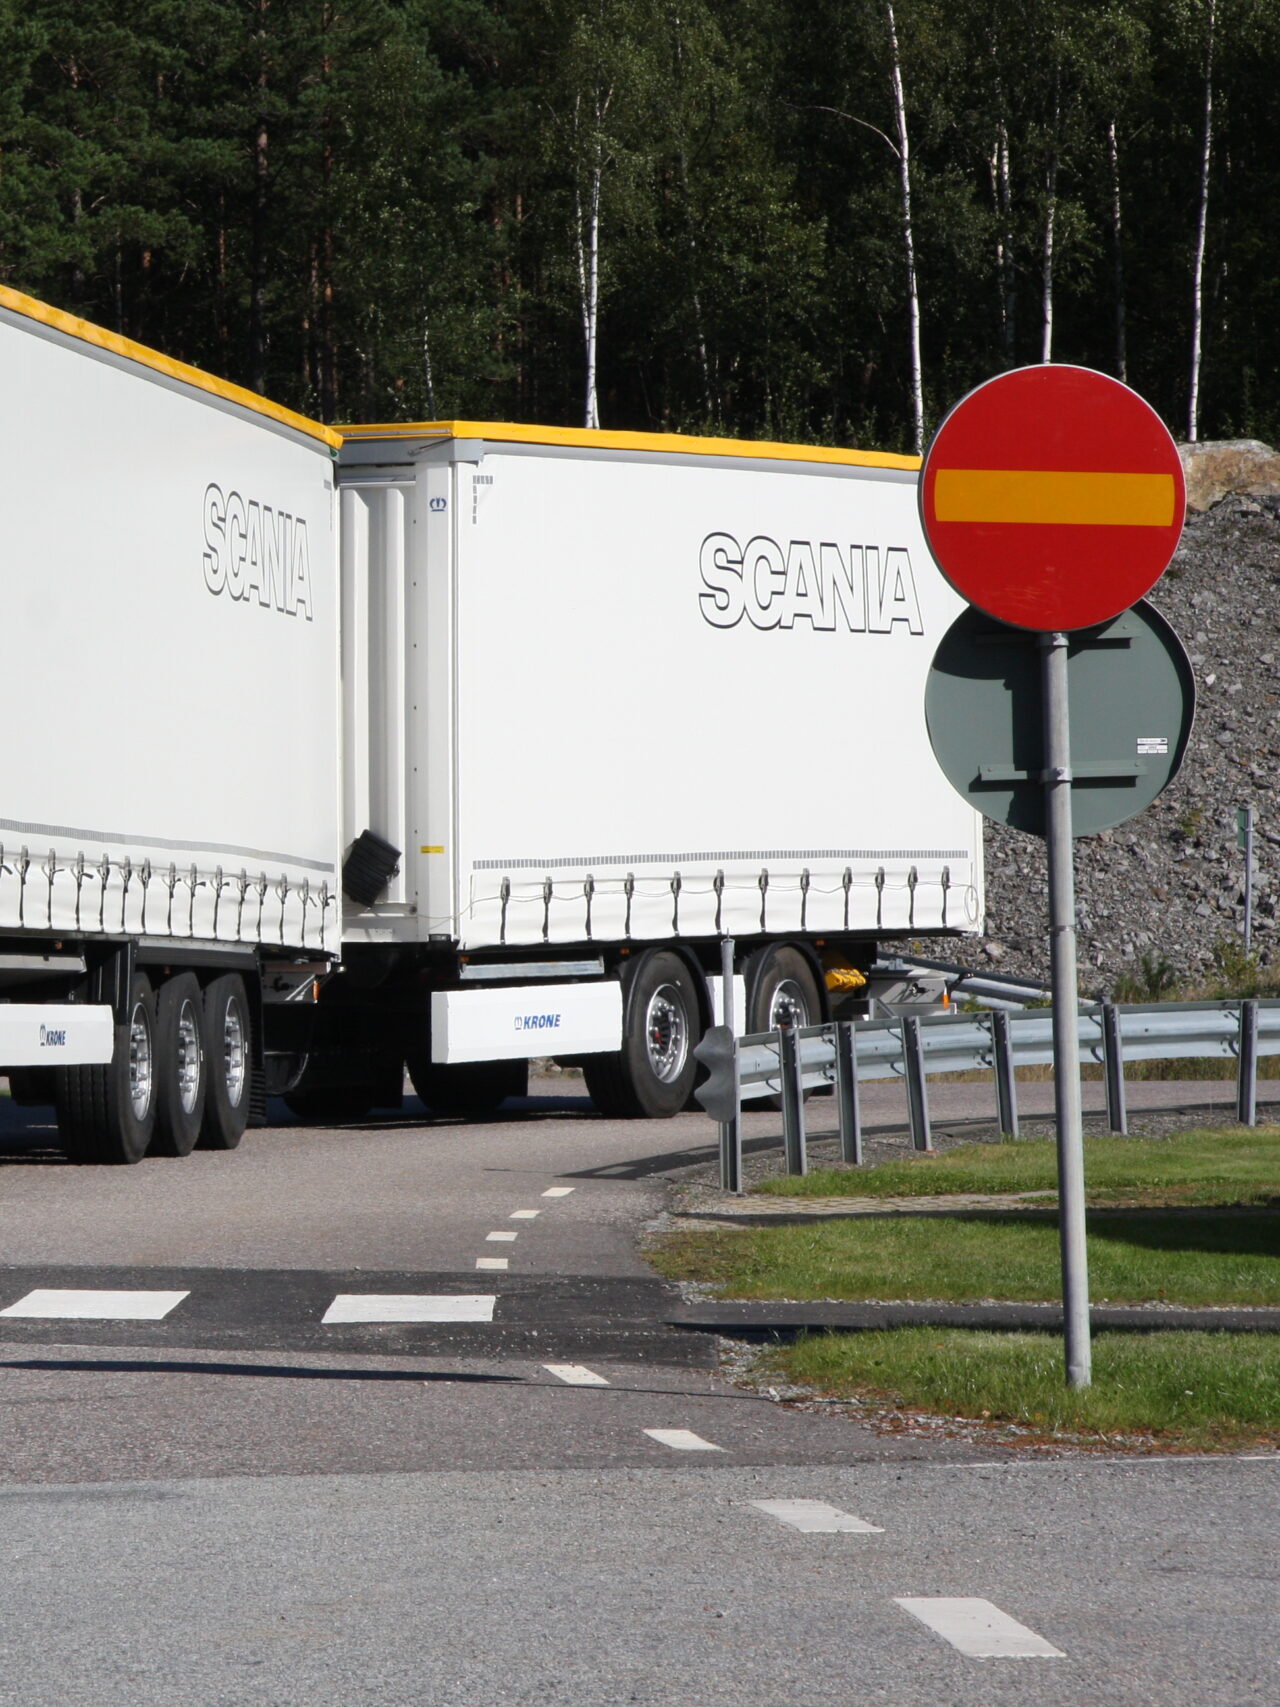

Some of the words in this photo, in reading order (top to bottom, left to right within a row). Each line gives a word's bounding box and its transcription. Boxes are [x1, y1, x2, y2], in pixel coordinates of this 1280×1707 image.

[202, 482, 313, 622] SCANIA
[698, 531, 924, 636] SCANIA
[45, 1030, 66, 1046] KRONE
[523, 1013, 561, 1030] KRONE
